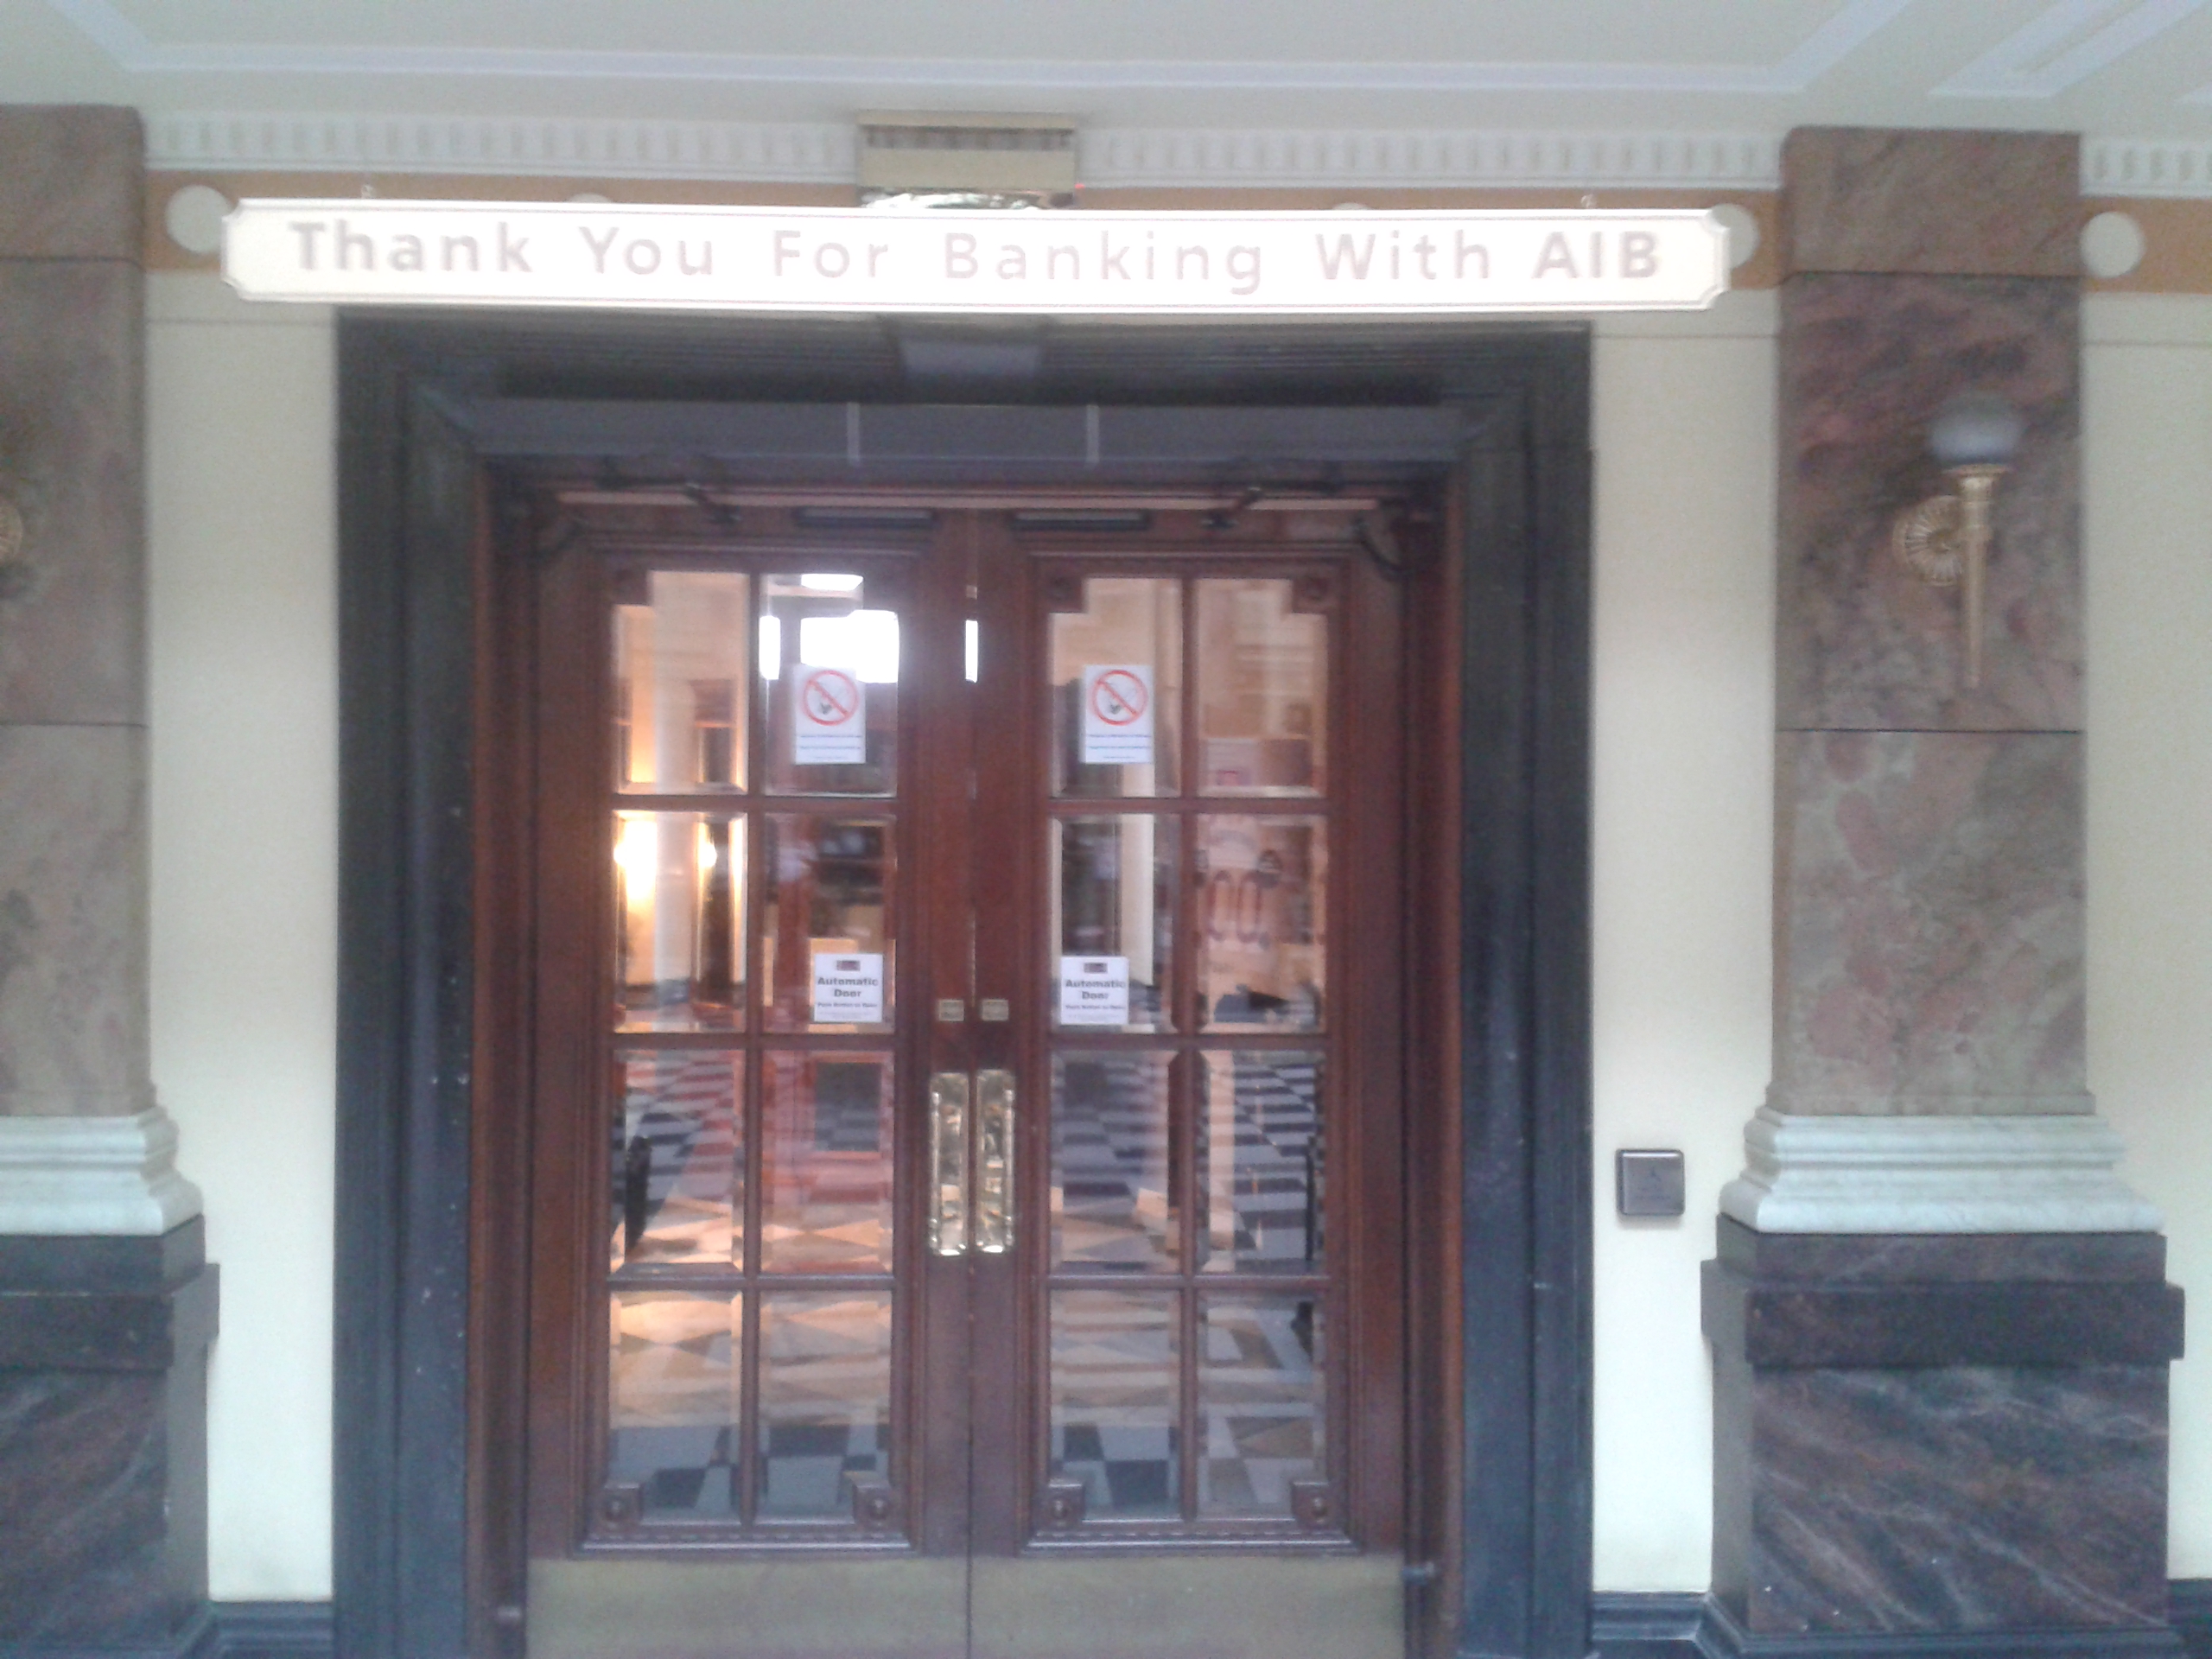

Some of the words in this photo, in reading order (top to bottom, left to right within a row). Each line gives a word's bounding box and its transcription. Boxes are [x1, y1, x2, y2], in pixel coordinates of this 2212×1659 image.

[288, 219, 533, 273] Thank
[578, 226, 714, 276] You
[773, 230, 888, 278] For
[944, 231, 1262, 296] Banking
[1315, 229, 1490, 281] With
[1531, 230, 1660, 280] AIB
[817, 976, 879, 987] Automatic
[1065, 979, 1127, 988] Automatic
[833, 988, 862, 998] Door
[1081, 991, 1109, 1000] Door
